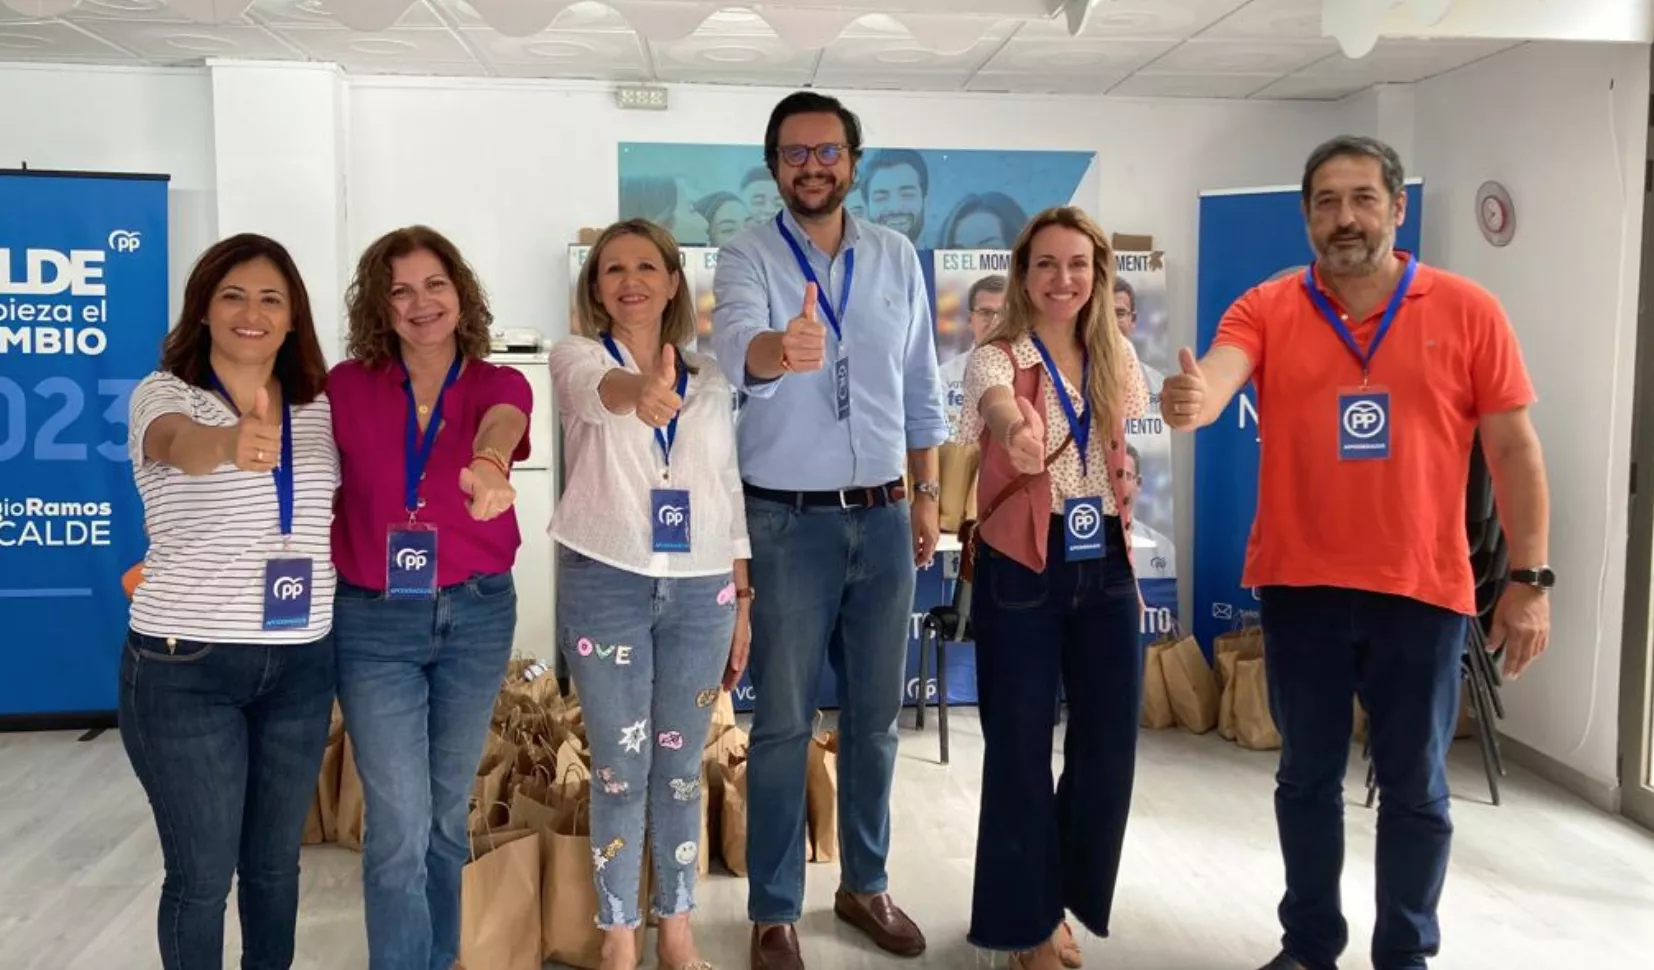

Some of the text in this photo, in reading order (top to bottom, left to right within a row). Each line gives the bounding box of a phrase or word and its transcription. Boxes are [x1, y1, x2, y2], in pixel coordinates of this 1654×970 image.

[943, 253, 959, 271] ES
[962, 253, 977, 271] EL
[82, 299, 107, 323] el
